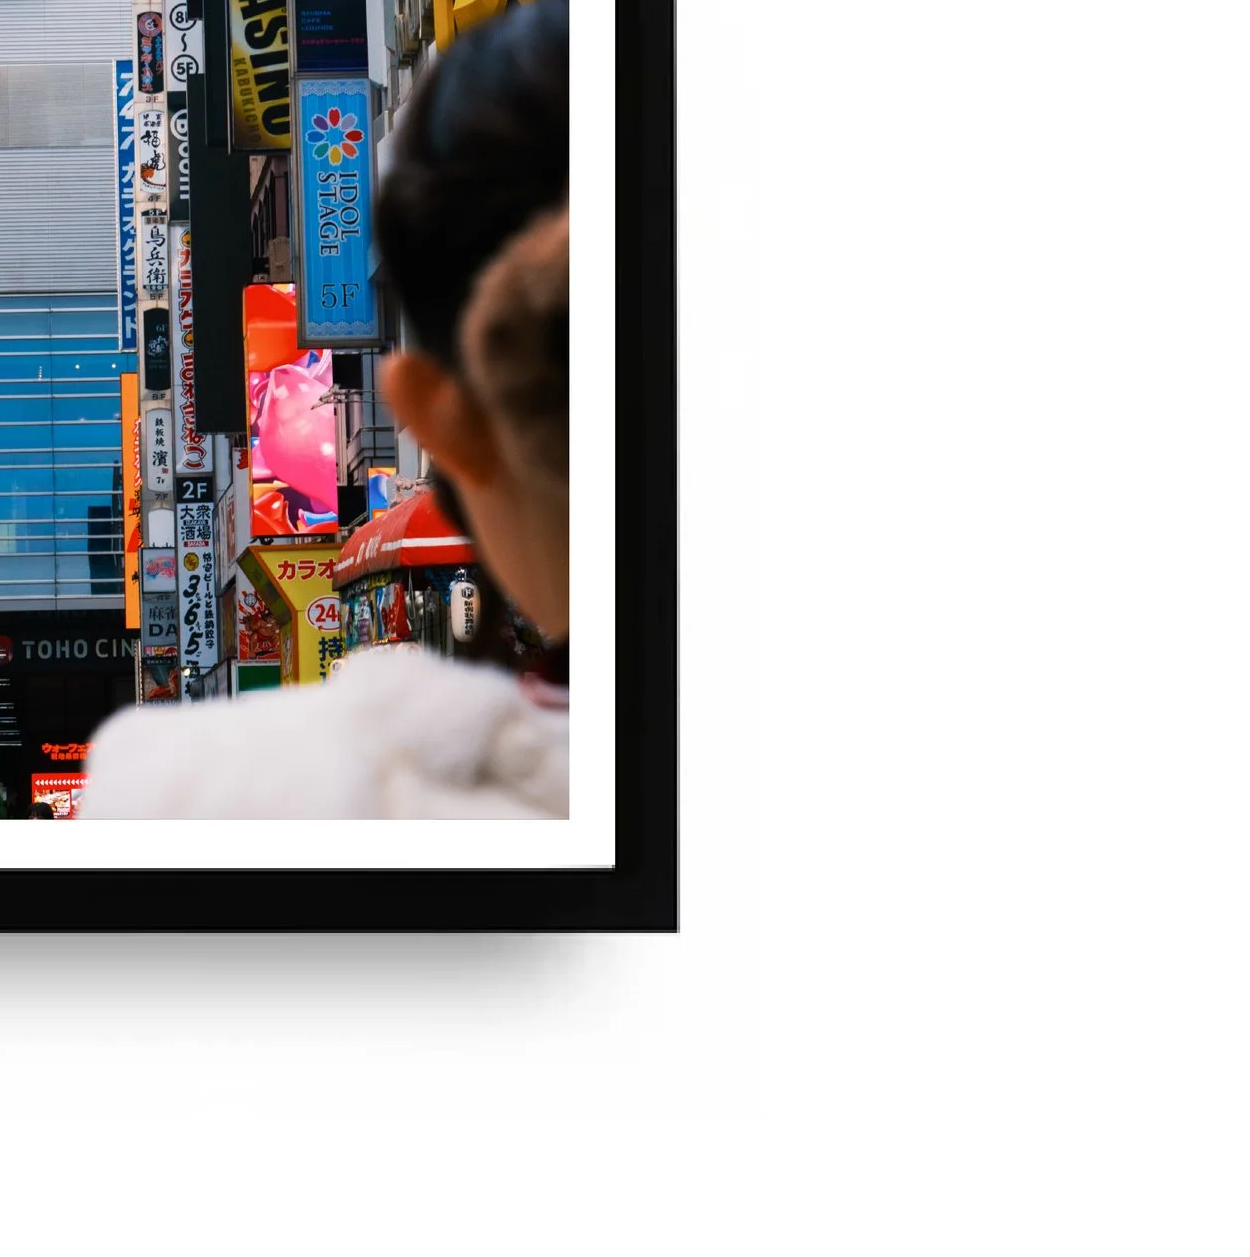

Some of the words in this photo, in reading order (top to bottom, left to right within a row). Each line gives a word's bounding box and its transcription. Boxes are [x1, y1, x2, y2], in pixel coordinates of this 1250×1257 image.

[317, 171, 341, 257] STAGE
[338, 170, 361, 241] IDOL
[321, 283, 361, 309] 5F
[182, 480, 208, 500] 2F
[180, 504, 211, 520] 大衆
[181, 526, 211, 541] 酒場
[22, 639, 88, 659] TOHO
